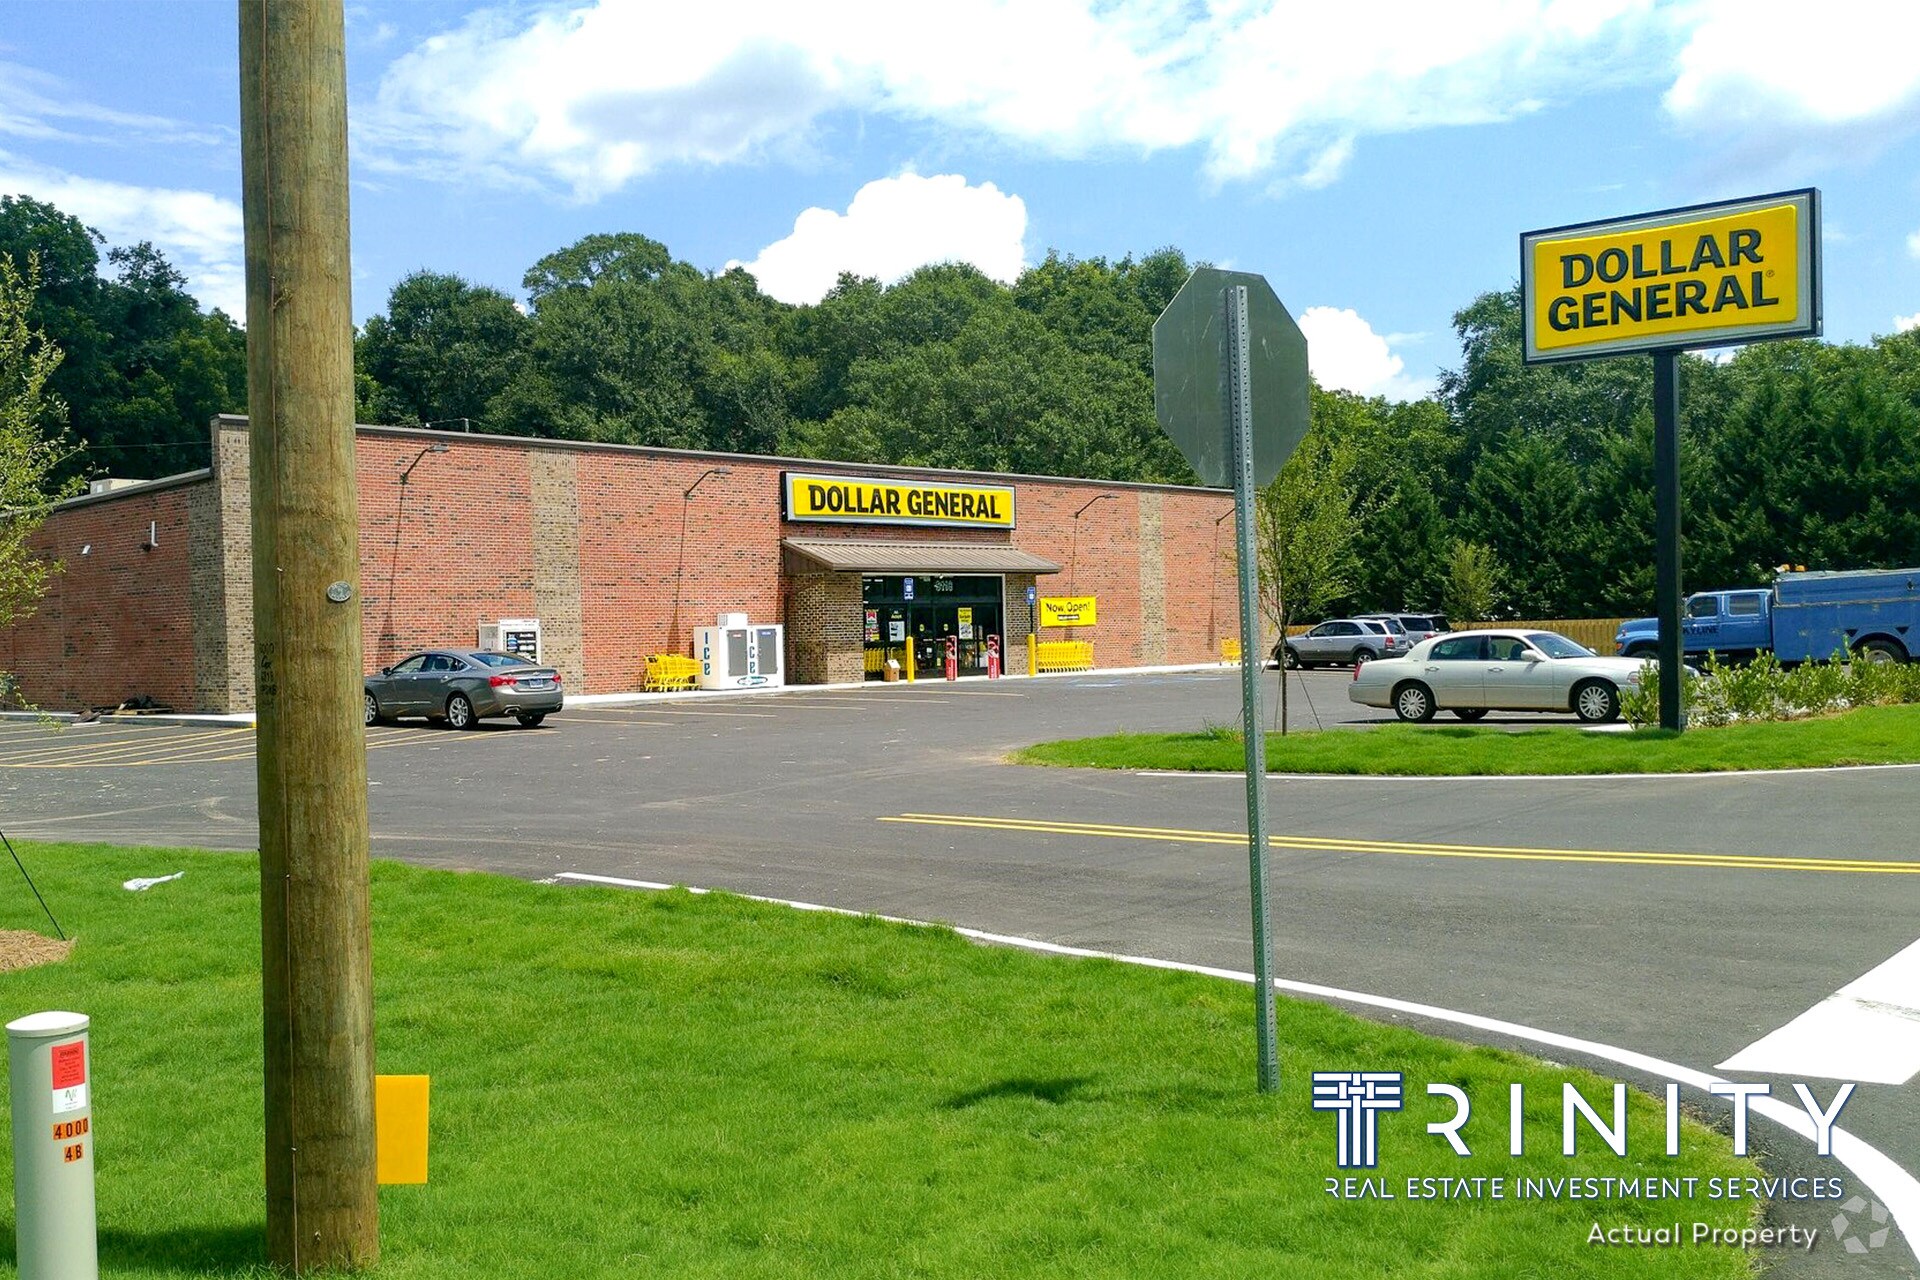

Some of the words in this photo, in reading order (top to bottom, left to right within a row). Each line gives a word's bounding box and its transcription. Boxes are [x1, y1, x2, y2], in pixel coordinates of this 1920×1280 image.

[1560, 228, 1764, 288] DOLLAR
[1548, 271, 1779, 331] GENERAL
[808, 485, 900, 514] DOLLAR
[907, 490, 1001, 518] GENERAL
[1046, 603, 1063, 612] Now
[1066, 602, 1090, 613] Open!
[1683, 625, 1720, 635] KYLINE
[55, 1118, 88, 1139] 4000
[65, 1144, 82, 1161] 4B
